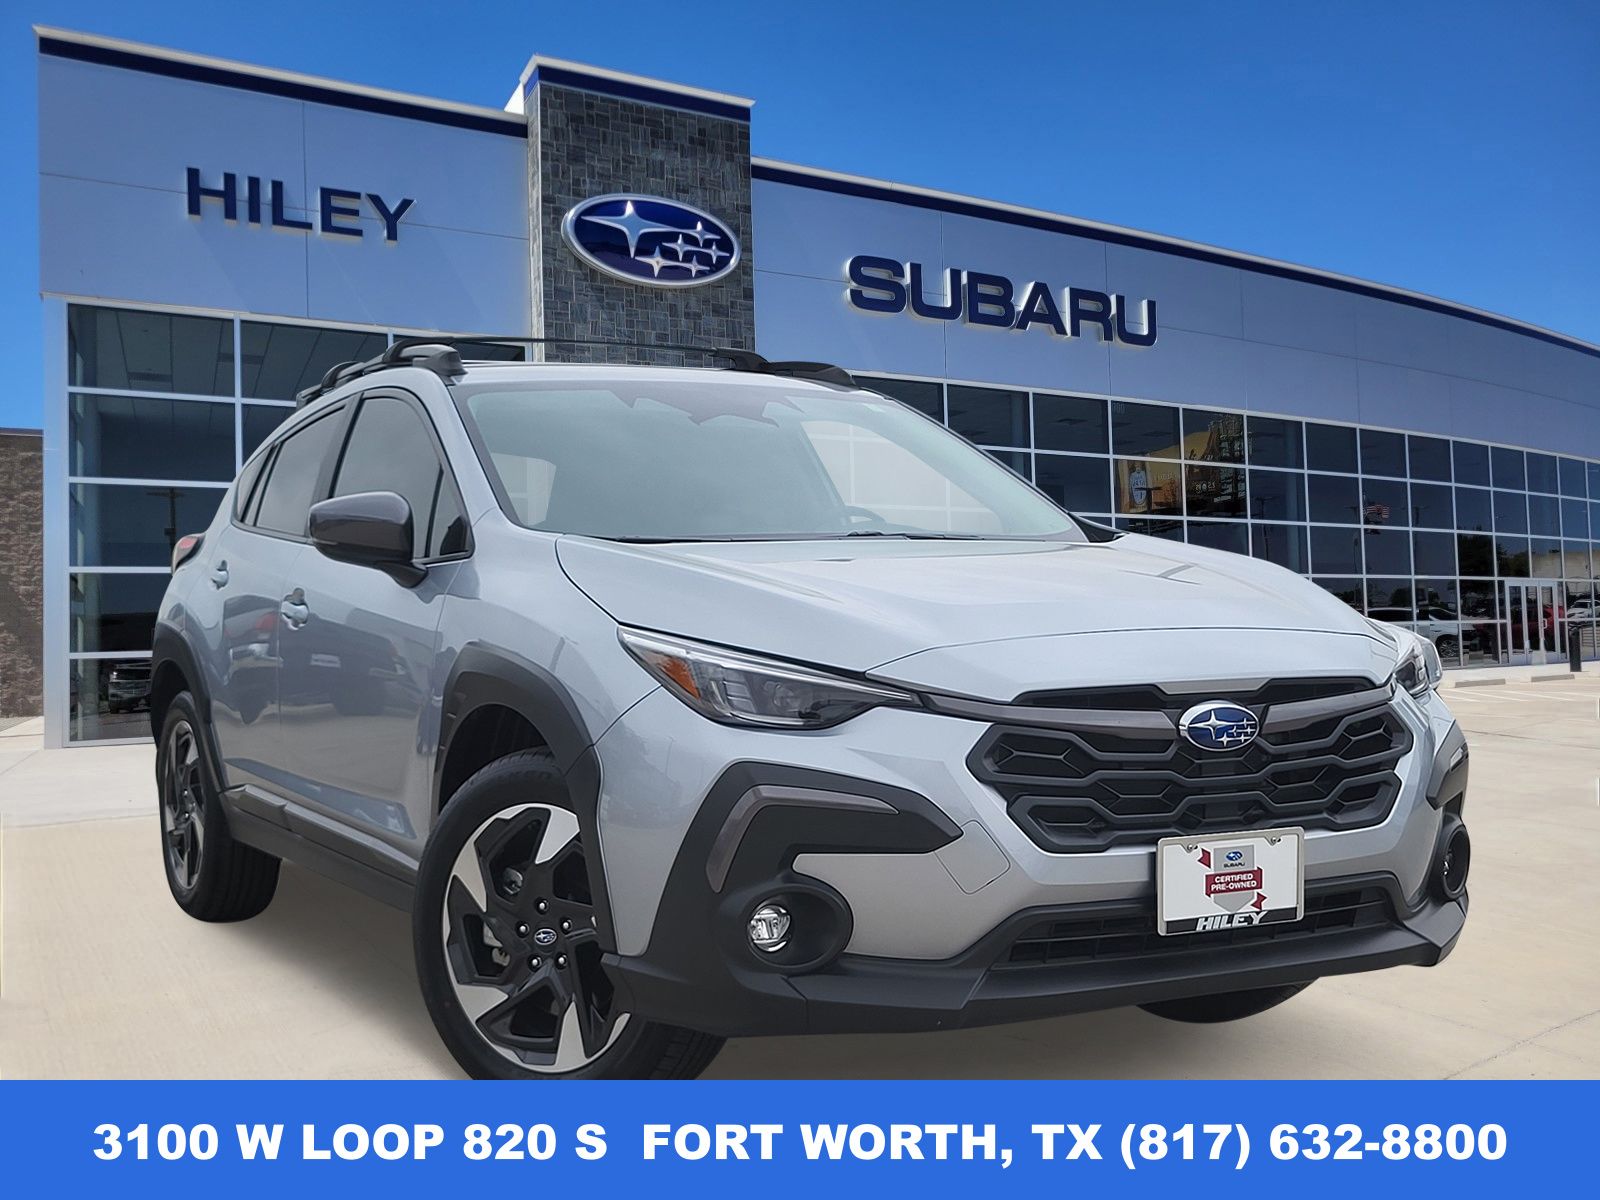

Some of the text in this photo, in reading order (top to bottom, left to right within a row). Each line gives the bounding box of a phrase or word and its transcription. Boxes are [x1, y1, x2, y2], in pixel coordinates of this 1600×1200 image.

[187, 167, 415, 241] HILEY
[848, 254, 1157, 347] SUBARU
[1211, 880, 1257, 891] PRE-OWNED
[1214, 873, 1254, 883] CERTIFIED
[1196, 910, 1268, 931] HILEY
